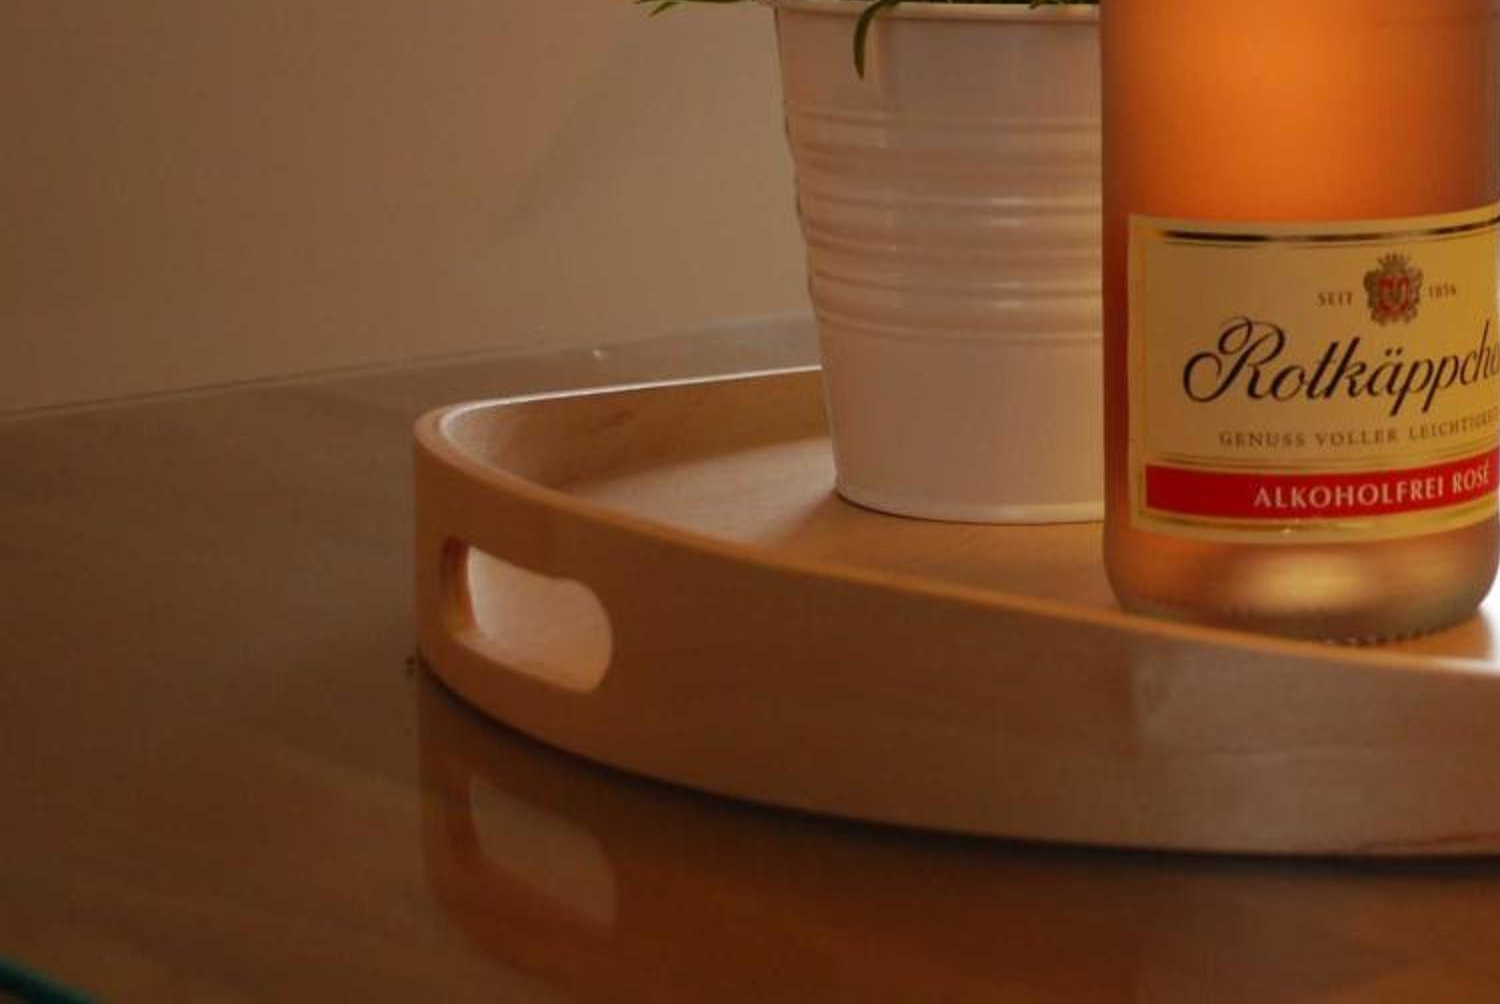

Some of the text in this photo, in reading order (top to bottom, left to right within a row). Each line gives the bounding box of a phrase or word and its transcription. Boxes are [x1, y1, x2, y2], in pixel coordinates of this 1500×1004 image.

[1318, 292, 1353, 306] SEIT
[1219, 430, 1305, 447] GENUSS
[1316, 427, 1398, 446] VOLLER
[1254, 458, 1489, 508] ALKOHOLFREI ROSÉ
